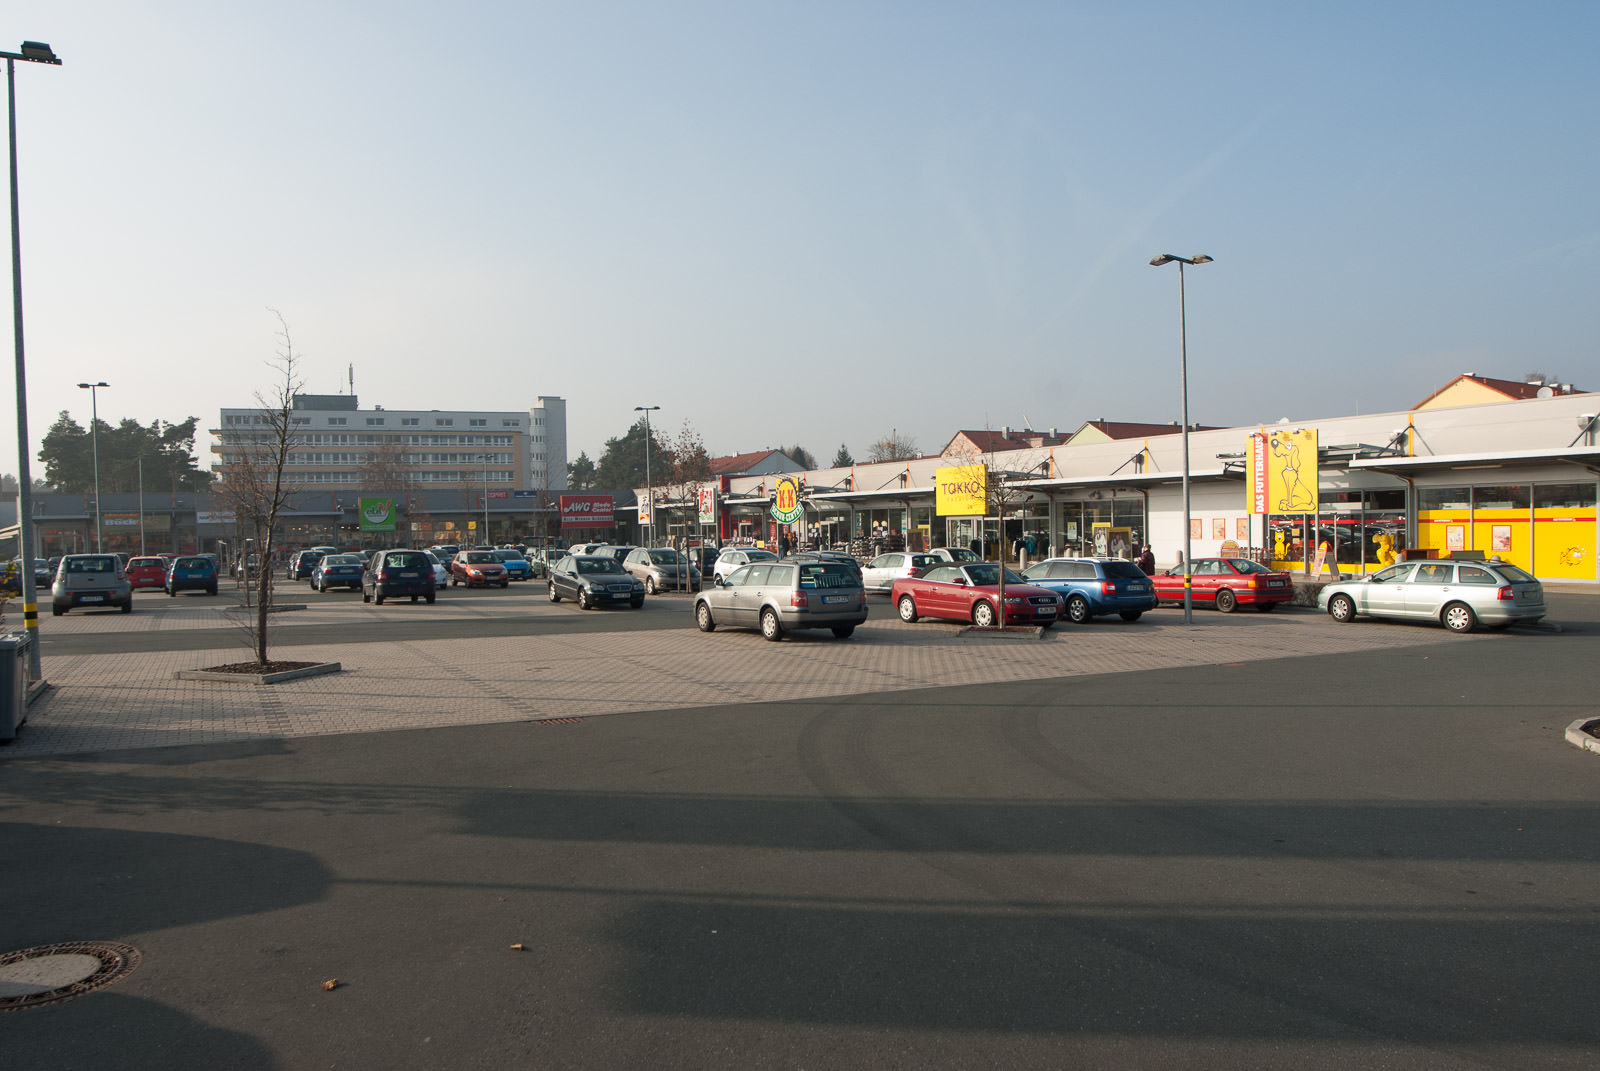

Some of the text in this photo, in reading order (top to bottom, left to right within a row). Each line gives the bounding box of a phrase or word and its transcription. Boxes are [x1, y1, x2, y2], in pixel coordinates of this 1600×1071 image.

[1255, 435, 1265, 512] DAS FUTTERHAUS
[941, 480, 980, 495] TOKKO
[563, 502, 591, 513] AWG
